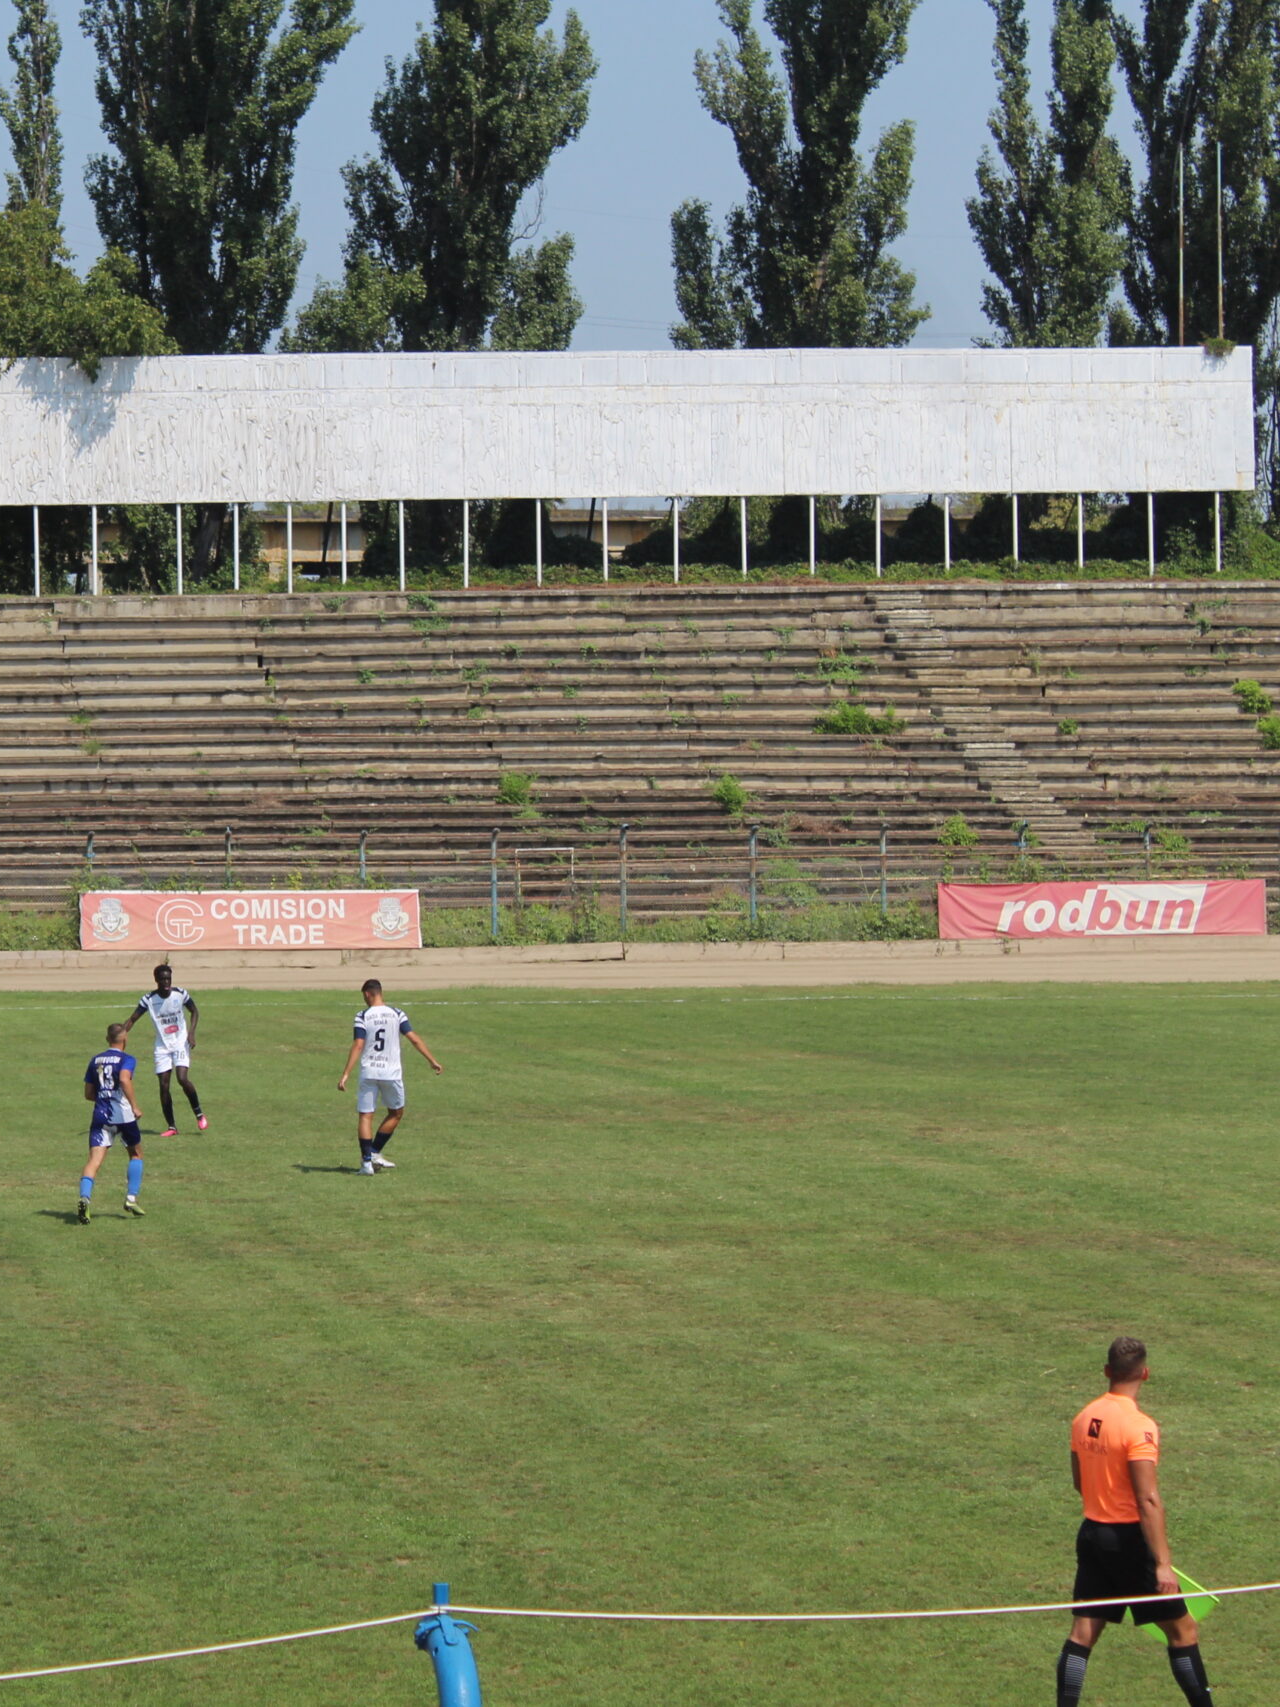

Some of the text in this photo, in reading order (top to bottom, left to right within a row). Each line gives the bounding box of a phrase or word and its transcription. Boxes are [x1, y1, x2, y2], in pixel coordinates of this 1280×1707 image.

[210, 898, 345, 920] COMISION
[997, 888, 1195, 932] rodbun
[233, 924, 325, 945] TRADE
[373, 1028, 386, 1052] 5
[96, 1064, 115, 1090] 13
